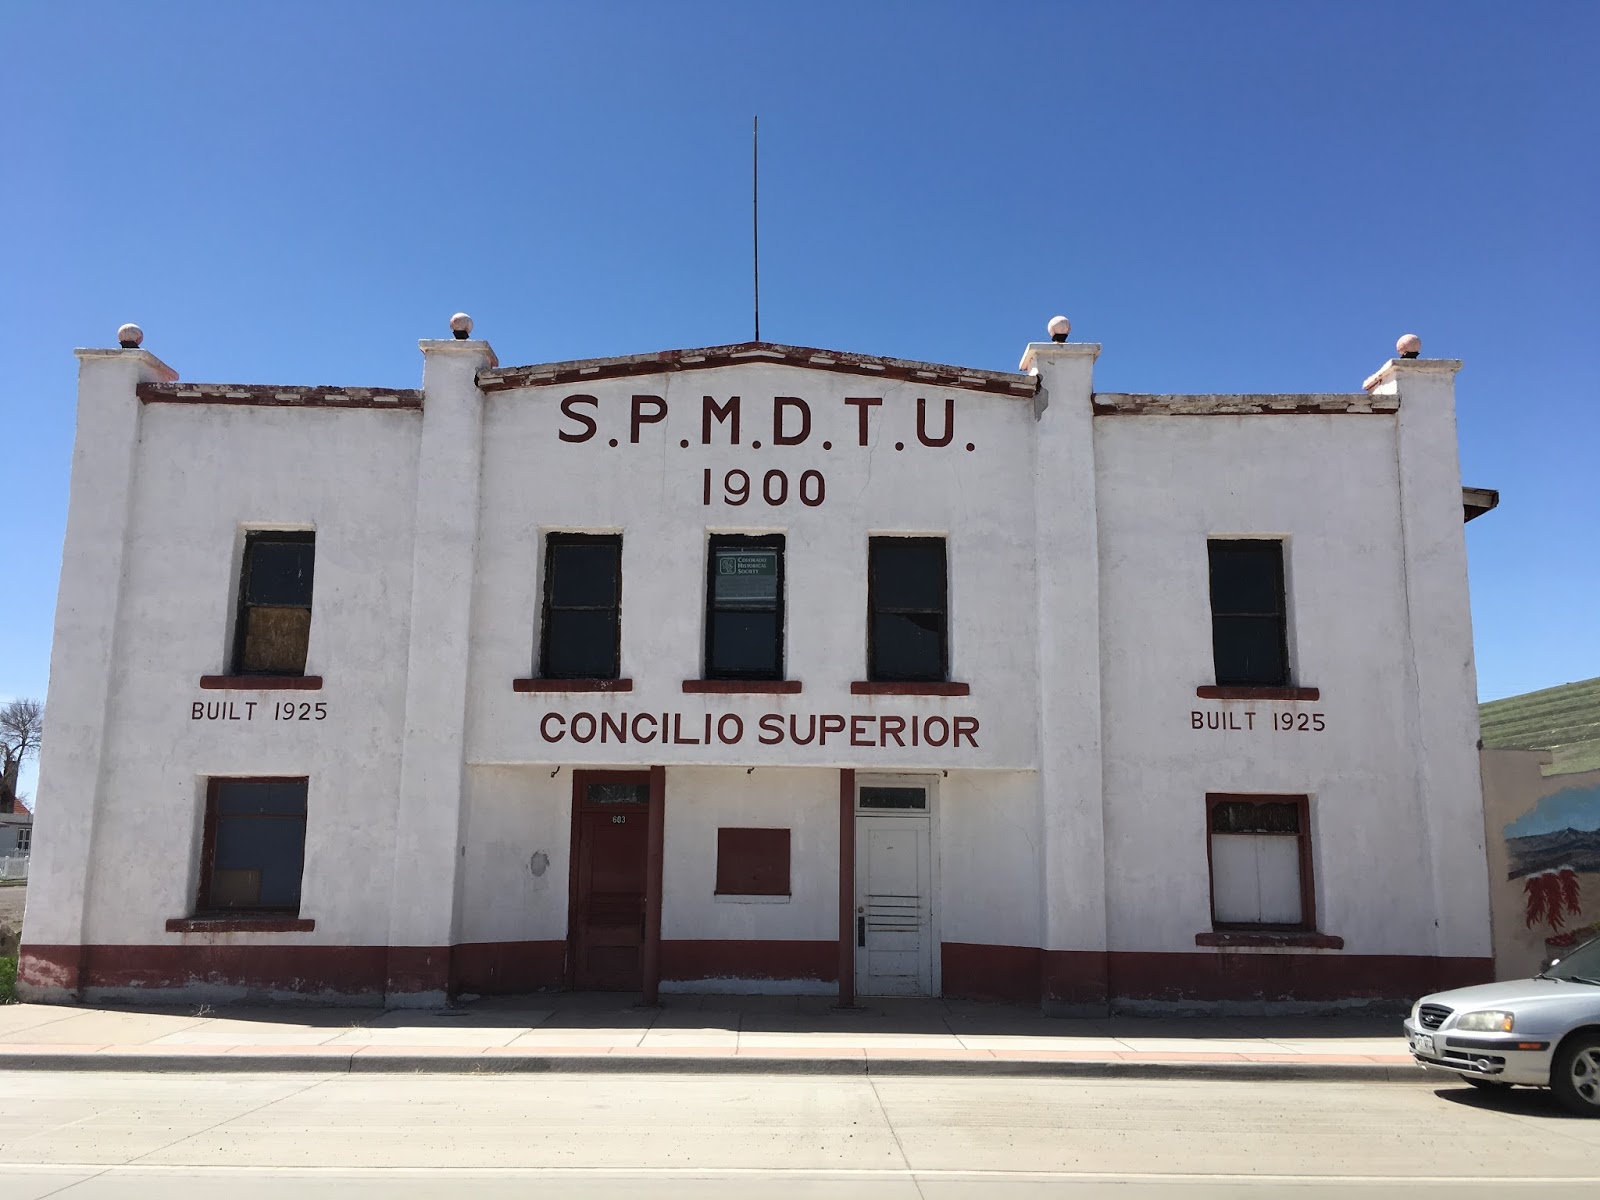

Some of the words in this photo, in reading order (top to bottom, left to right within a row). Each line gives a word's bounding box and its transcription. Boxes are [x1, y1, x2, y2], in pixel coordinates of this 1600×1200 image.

[558, 393, 976, 452] S.P.M.D.T.U.
[703, 468, 826, 507] 1900
[191, 701, 258, 721] BUILT
[274, 701, 328, 721] 1925
[539, 711, 744, 745] CONCILIO
[758, 713, 980, 748] SUPERIOR
[1190, 710, 1257, 731] BUILT
[1273, 711, 1326, 732] 1925
